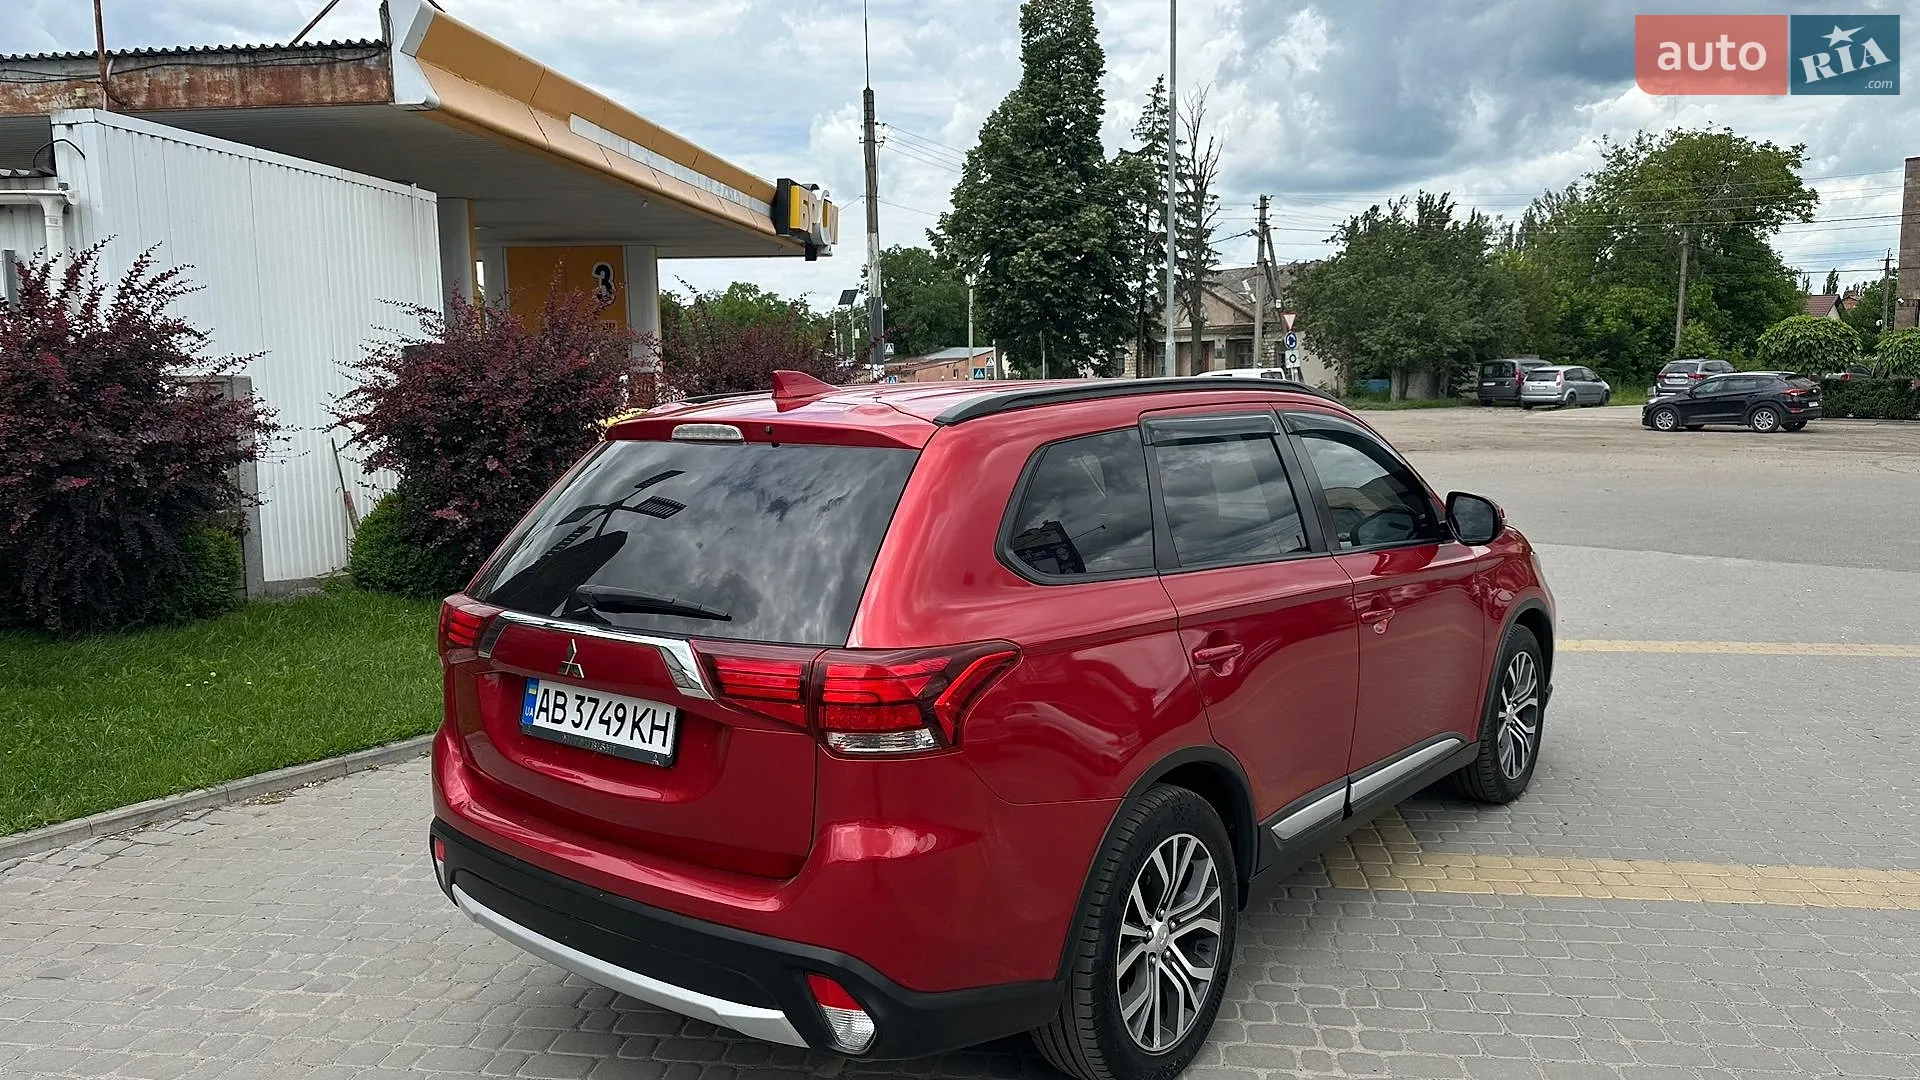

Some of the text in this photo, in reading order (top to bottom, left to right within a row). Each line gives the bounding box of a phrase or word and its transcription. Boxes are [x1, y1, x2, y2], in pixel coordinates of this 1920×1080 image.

[592, 262, 615, 307] 3
[524, 706, 534, 717] UA
[536, 688, 671, 748] AB 3749 KH
